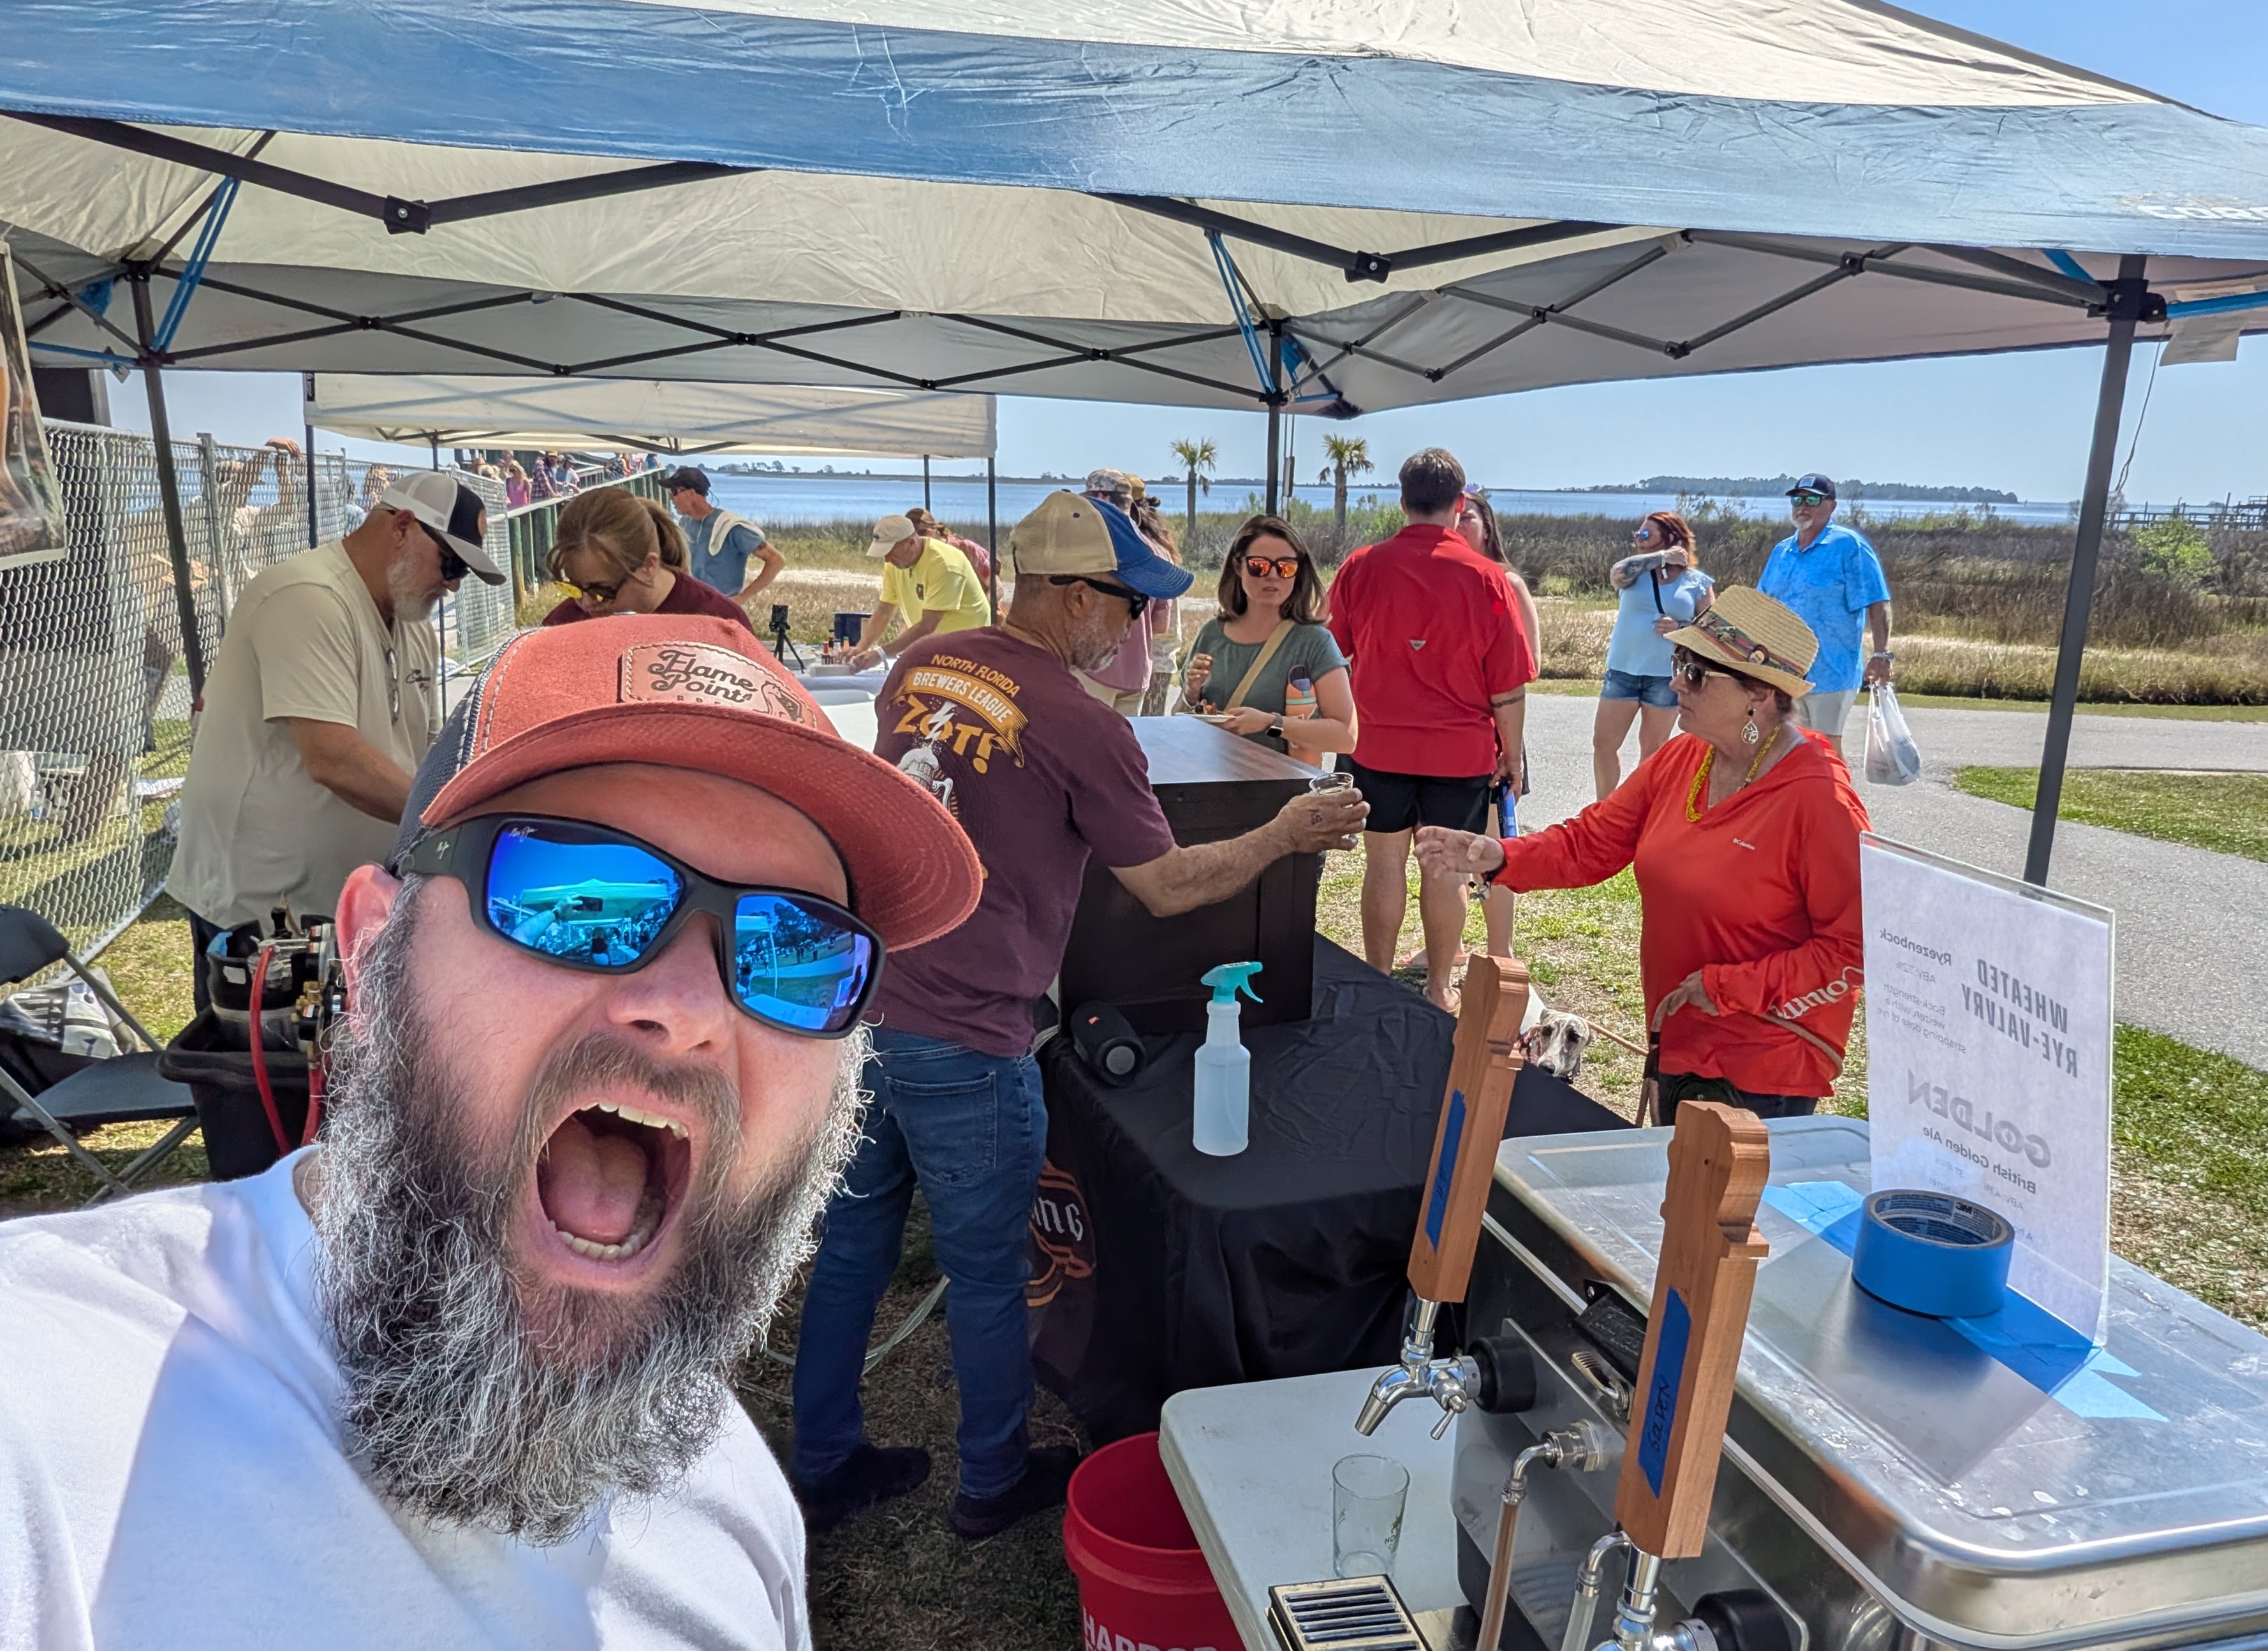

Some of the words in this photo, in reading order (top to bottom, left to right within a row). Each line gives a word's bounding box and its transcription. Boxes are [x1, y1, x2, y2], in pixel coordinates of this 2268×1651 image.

[648, 649, 758, 692] Flame
[651, 667, 747, 703] Point
[931, 654, 978, 673] NORTH
[975, 665, 1020, 698] FLORIDA
[913, 672, 971, 696] BREWERS
[968, 685, 1013, 723] LEAGUE
[893, 694, 998, 774] ZOT!
[1955, 1202, 1973, 1215] 3M
[1647, 1373, 1672, 1453] GOLDEN
